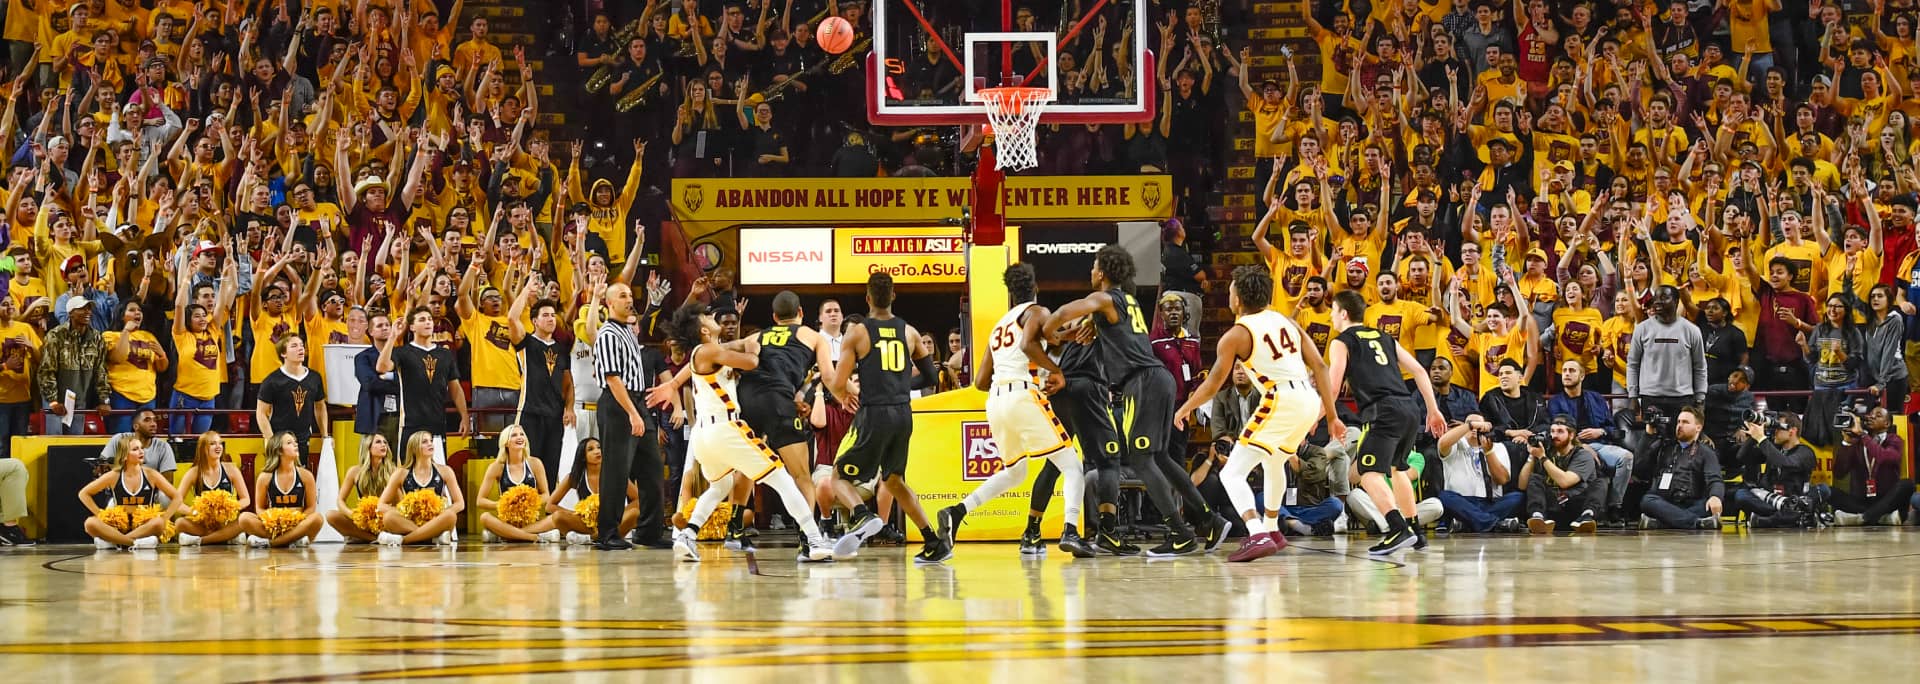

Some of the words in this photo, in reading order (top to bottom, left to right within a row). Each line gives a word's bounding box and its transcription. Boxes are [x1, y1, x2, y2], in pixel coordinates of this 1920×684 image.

[716, 188, 808, 208] ABANDON
[815, 189, 849, 207] ALL
[855, 188, 905, 207] HOPE
[913, 188, 938, 207] YE
[1005, 187, 1068, 206] ENTER
[1077, 187, 1130, 205] HERE
[855, 239, 923, 252] CAMPAIGN
[924, 239, 952, 252] ASU
[748, 251, 823, 262] NISSAN
[868, 263, 966, 276] GiveTo.ASU.e
[1127, 307, 1149, 334] 24
[991, 321, 1015, 351] 35
[1263, 327, 1297, 360] 14
[576, 350, 590, 359] SUN
[875, 340, 905, 372] 10
[1368, 339, 1388, 365] 3
[968, 460, 1003, 475] 202
